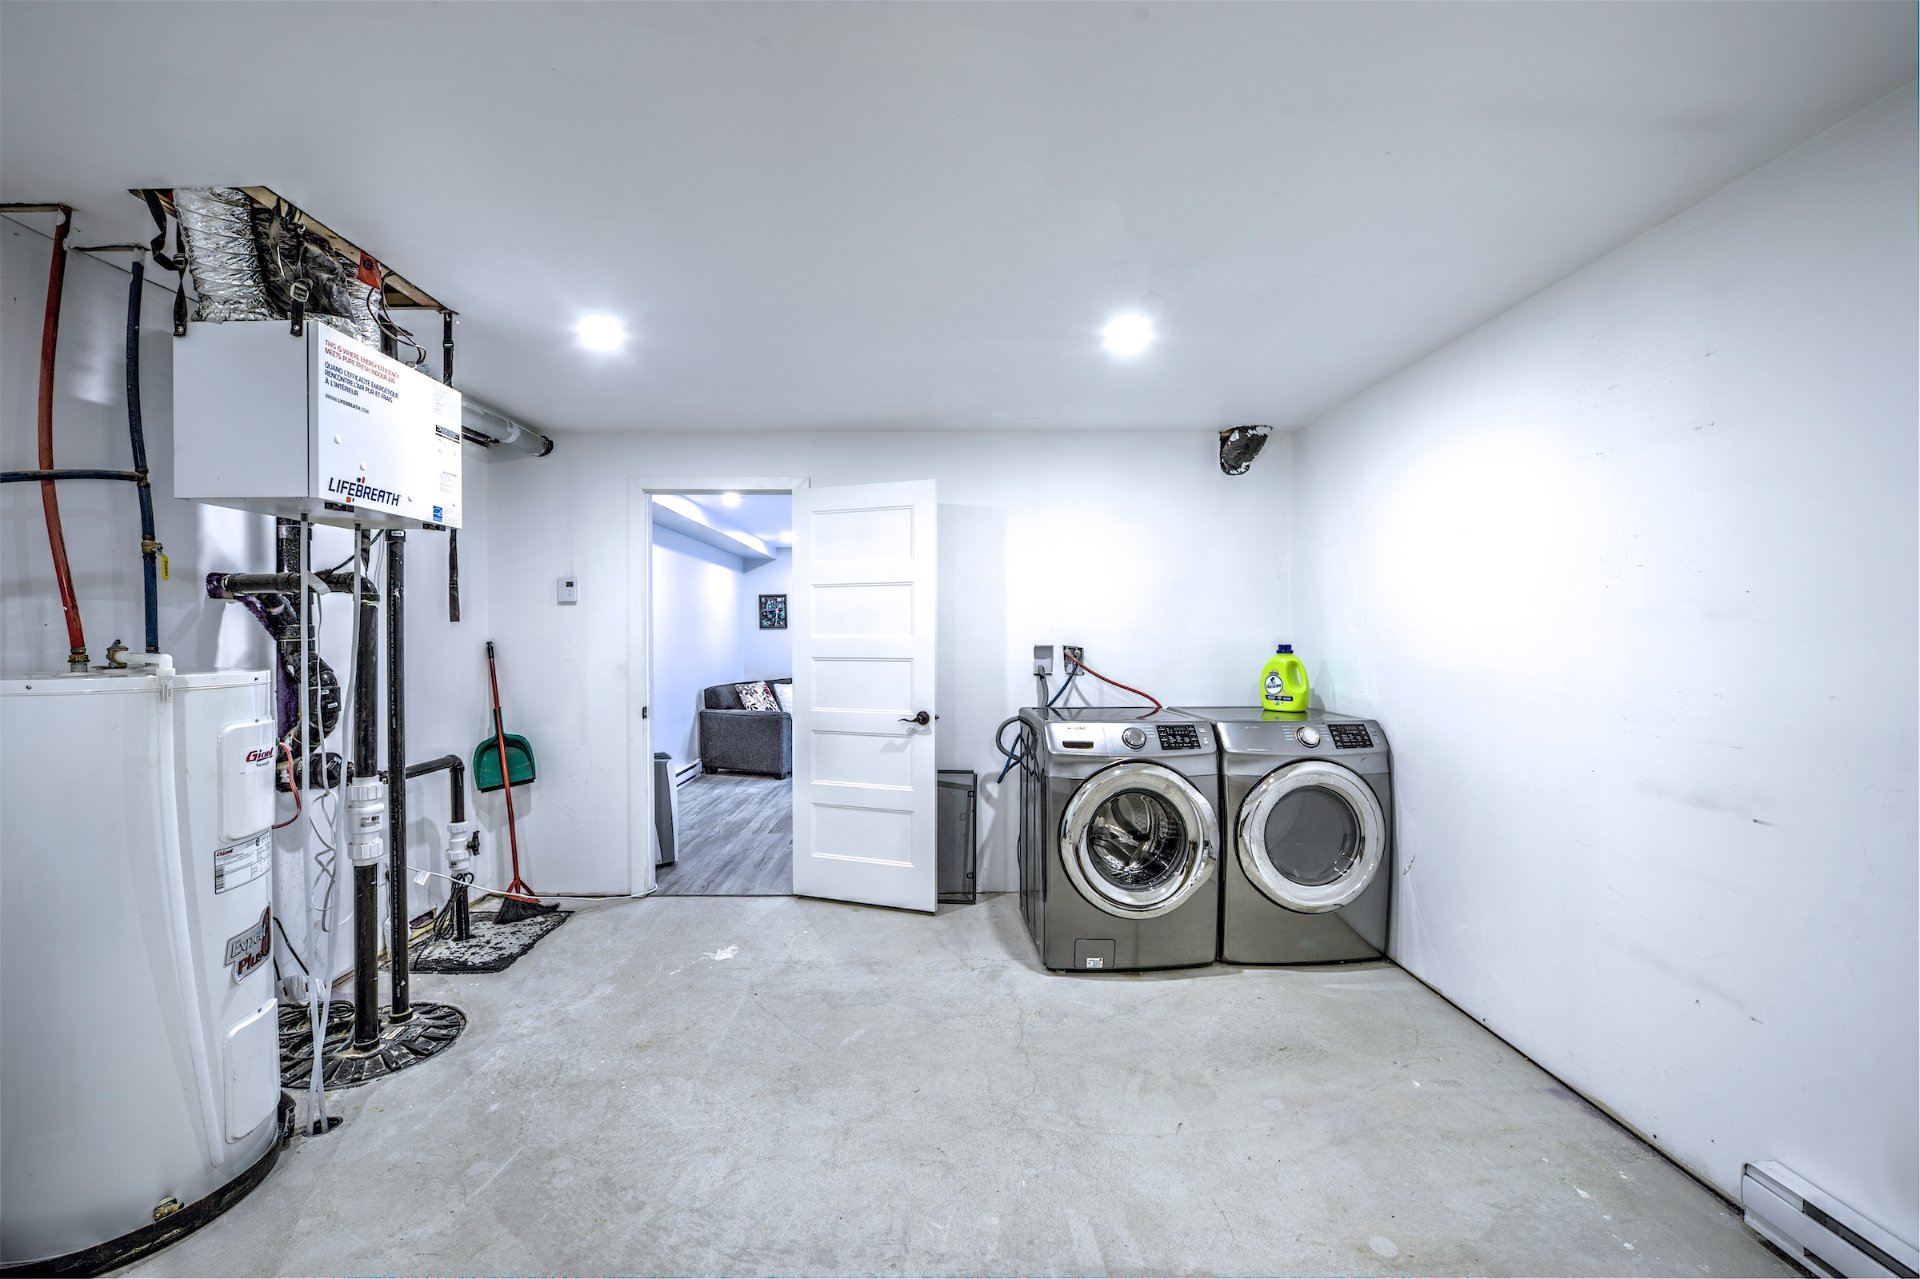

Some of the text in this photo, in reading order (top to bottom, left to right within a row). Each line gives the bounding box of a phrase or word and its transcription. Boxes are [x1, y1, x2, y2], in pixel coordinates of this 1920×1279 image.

[325, 339, 337, 350] THIS
[337, 345, 343, 353] IS
[343, 347, 359, 360] WHERE
[360, 356, 377, 368] ENERGY
[325, 347, 341, 360] MEETS
[342, 355, 355, 367] PURE
[356, 361, 371, 373] FRESH
[325, 361, 343, 375] QUAND
[324, 369, 355, 387] RENCONTRE
[365, 386, 375, 395] PUR
[380, 393, 393, 403] FRAIS
[328, 477, 400, 507] LIFEBREATH
[246, 747, 274, 763] Giant
[238, 951, 263, 976] Plus
